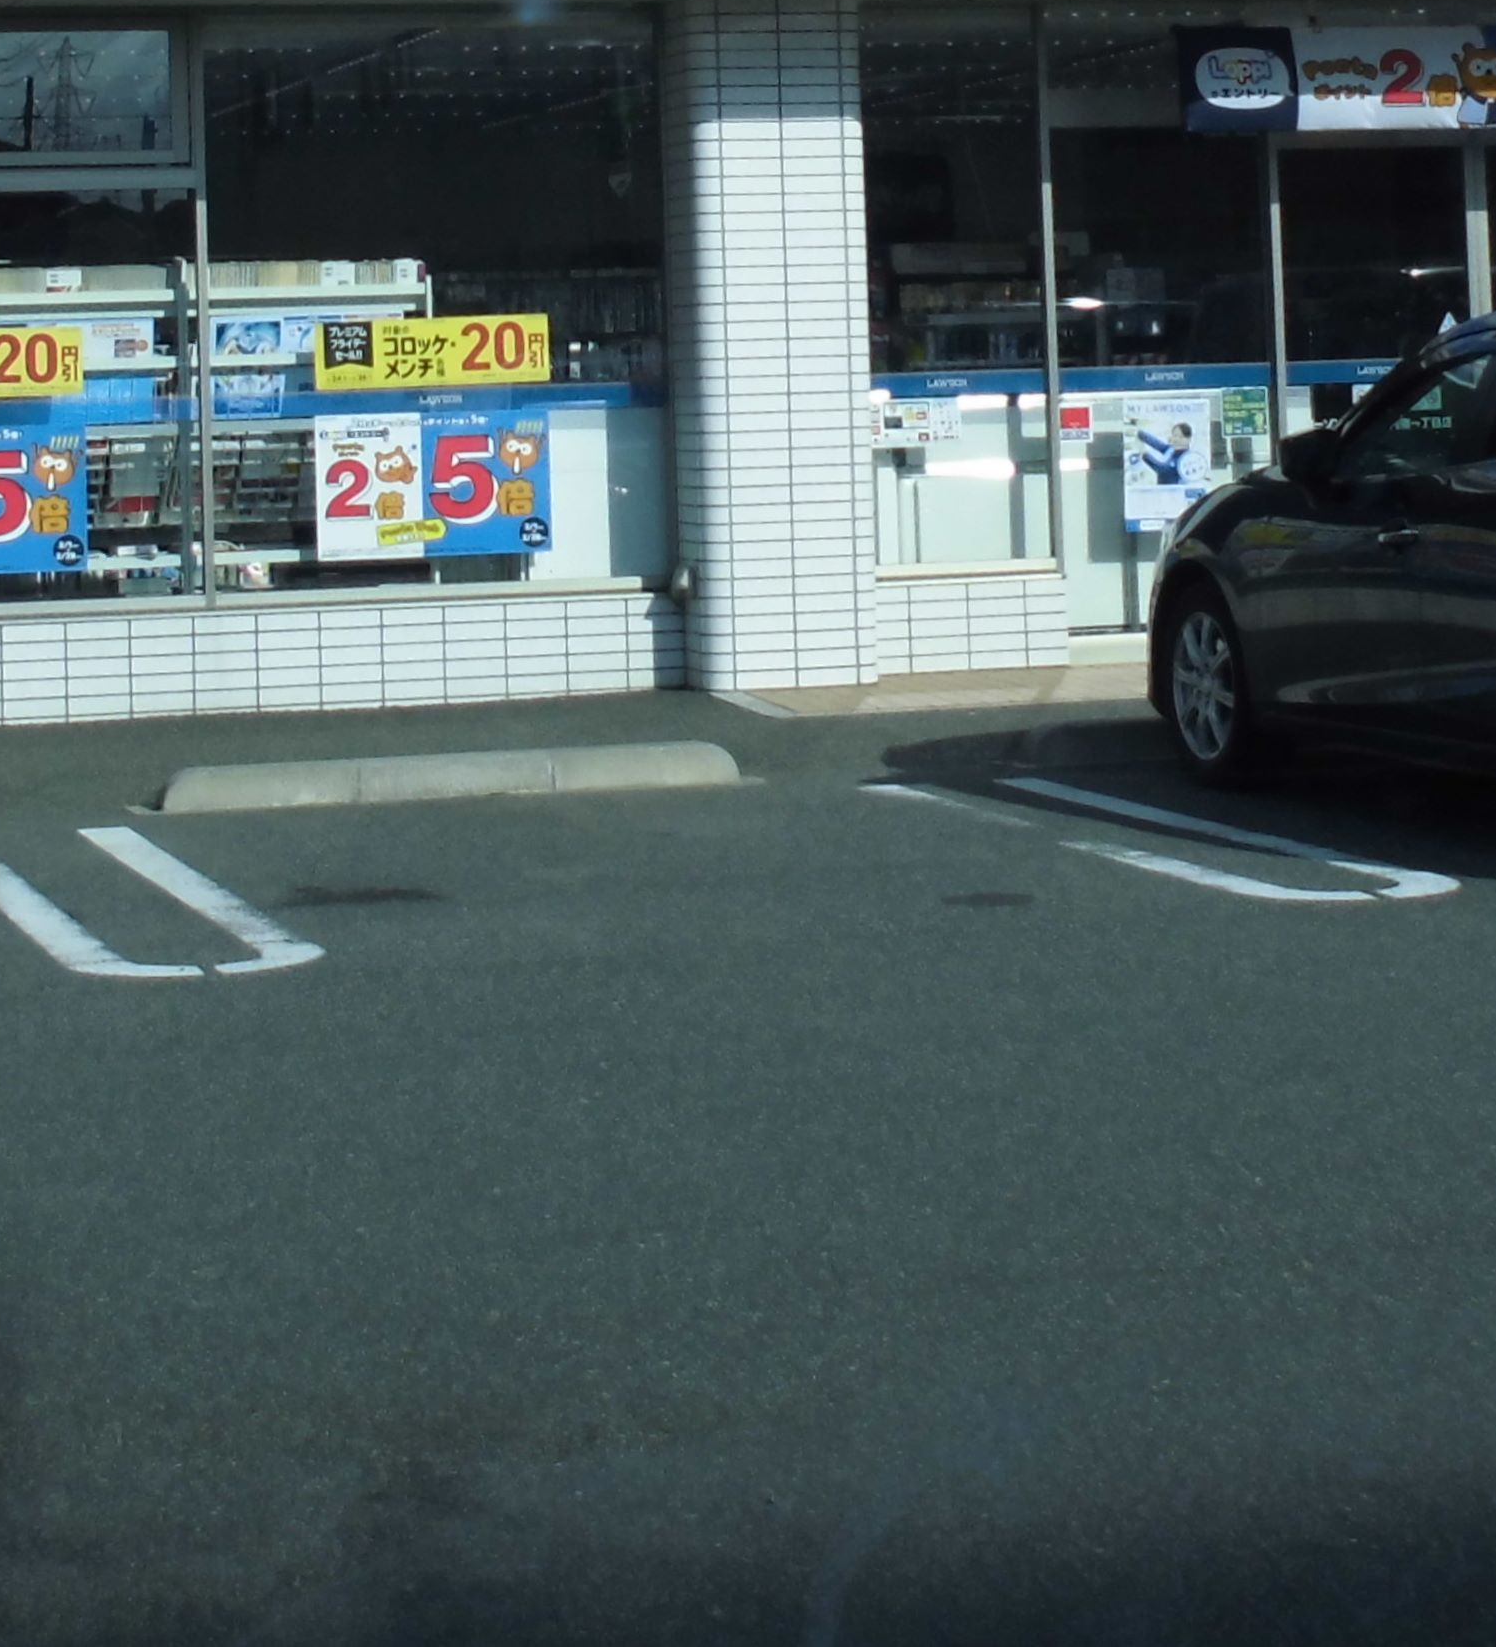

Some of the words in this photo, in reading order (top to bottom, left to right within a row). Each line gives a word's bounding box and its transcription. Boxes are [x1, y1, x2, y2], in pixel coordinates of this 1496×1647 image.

[1207, 56, 1273, 84] Loppi
[1379, 48, 1426, 108] 2
[926, 378, 968, 388] LAWSON
